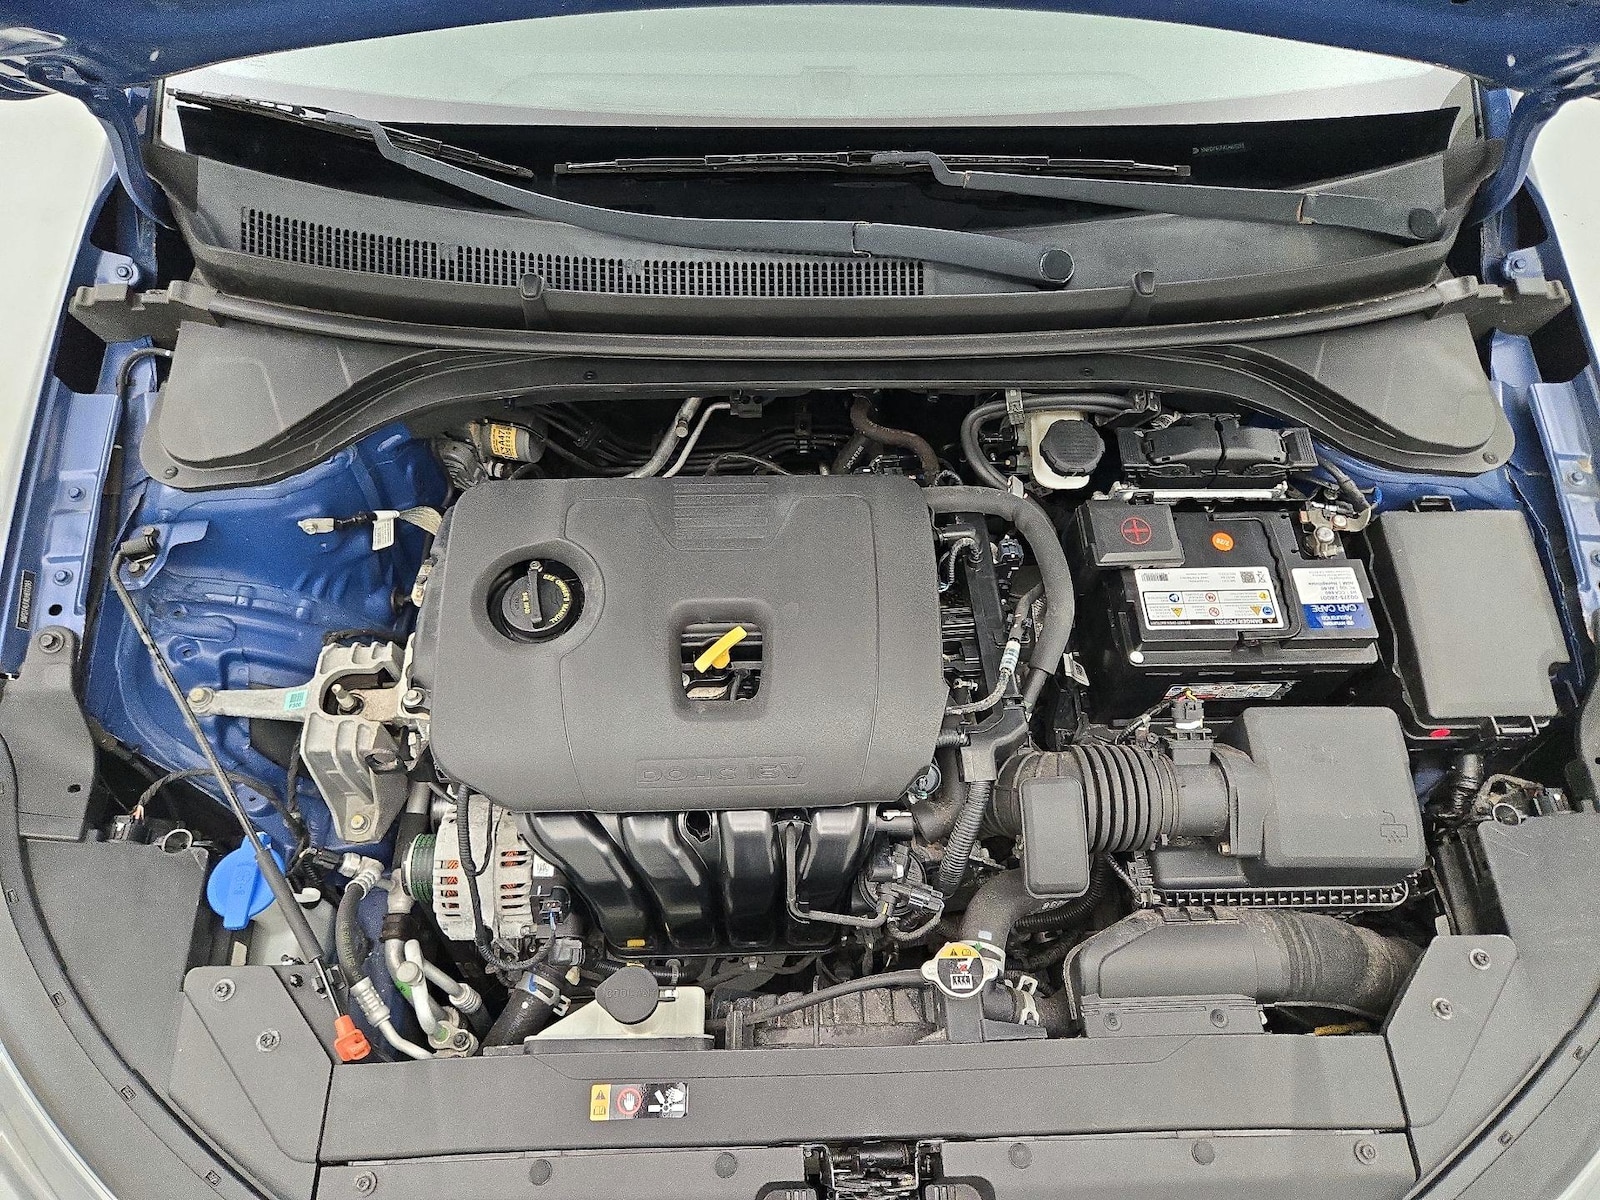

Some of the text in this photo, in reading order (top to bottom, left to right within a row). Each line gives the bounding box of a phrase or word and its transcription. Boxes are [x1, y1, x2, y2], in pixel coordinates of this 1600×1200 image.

[549, 603, 569, 624] MANUAL
[1310, 604, 1357, 613] CAR CARE
[638, 762, 805, 782] DOHC 16V
